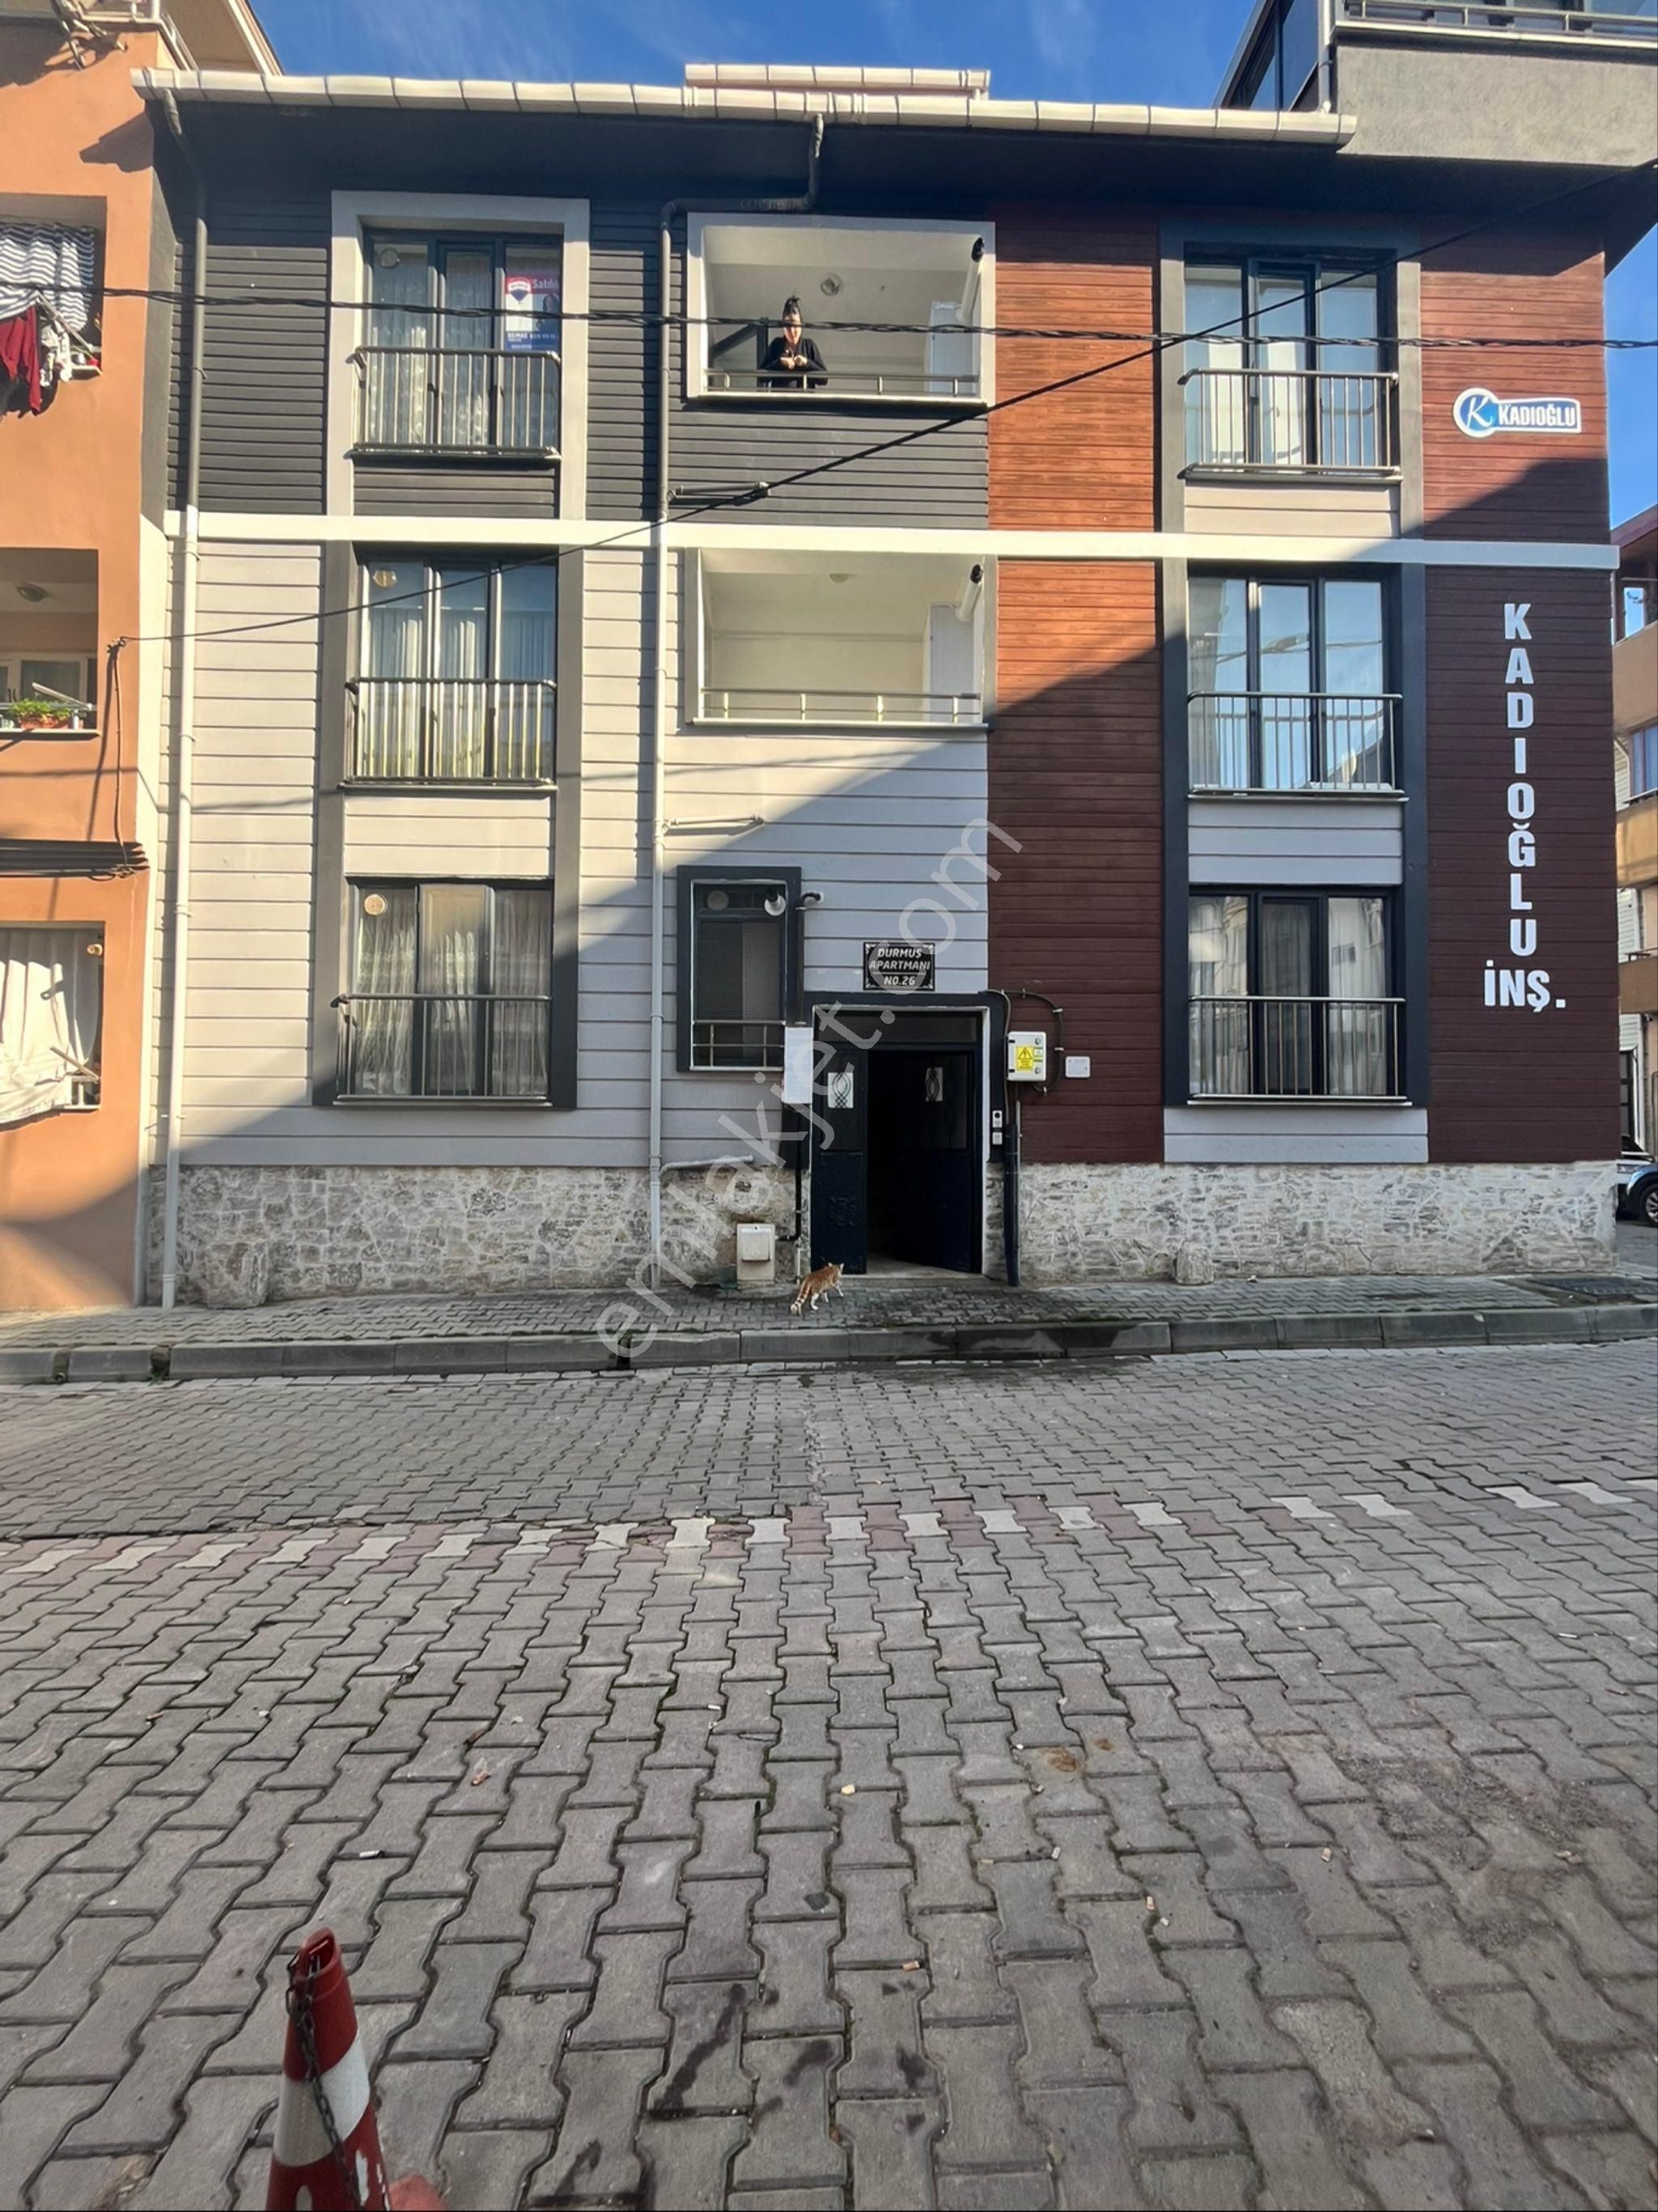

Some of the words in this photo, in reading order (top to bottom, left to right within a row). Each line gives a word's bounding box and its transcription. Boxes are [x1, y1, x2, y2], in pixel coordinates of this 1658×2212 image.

[1498, 403, 1576, 427] KADIOĞLU
[1503, 603, 1537, 957] KADIOĞLU
[869, 960, 931, 970] APARTMANI
[1484, 960, 1567, 1013] İNŞ.
